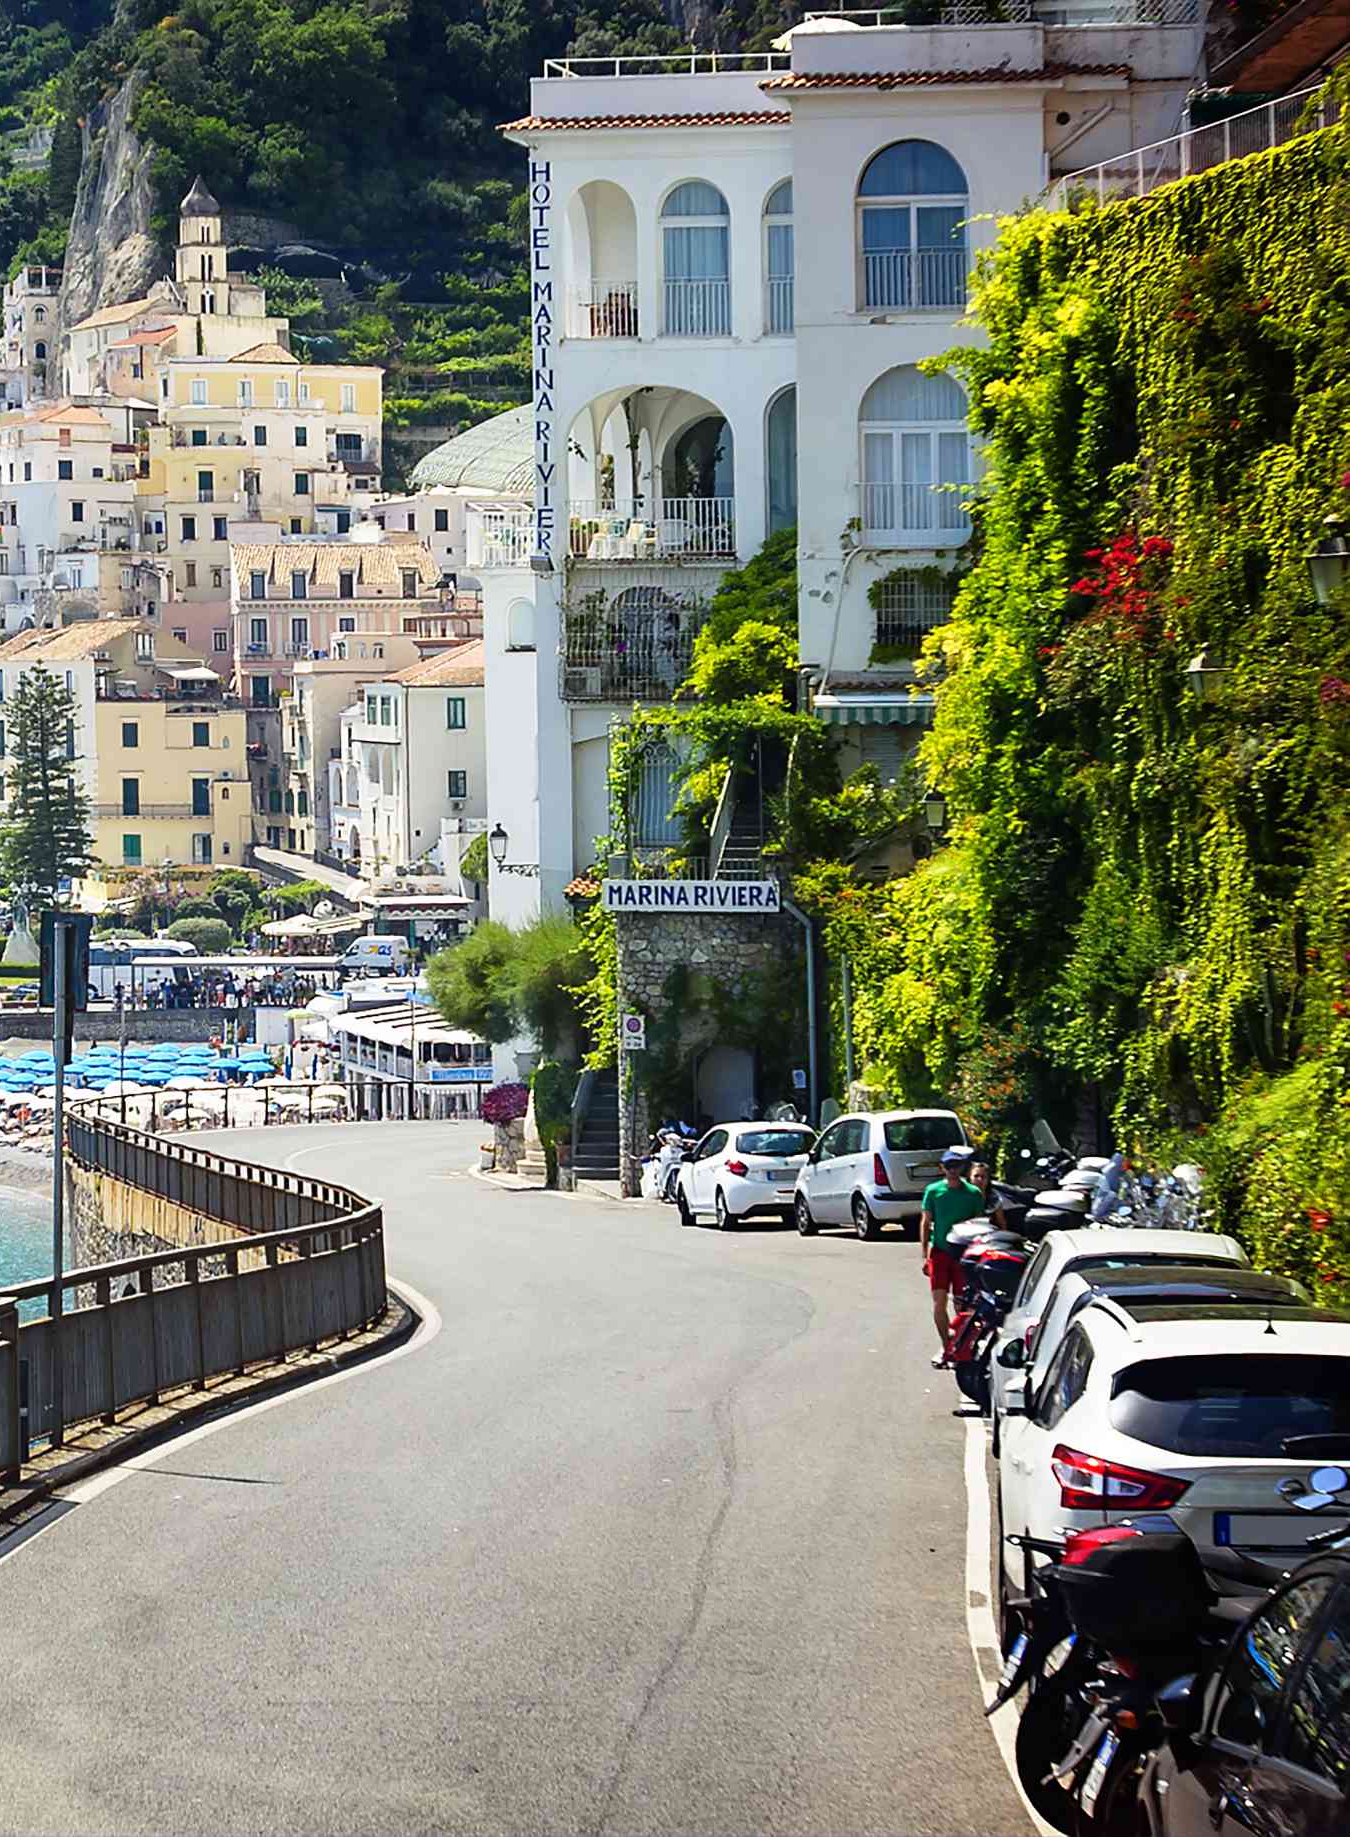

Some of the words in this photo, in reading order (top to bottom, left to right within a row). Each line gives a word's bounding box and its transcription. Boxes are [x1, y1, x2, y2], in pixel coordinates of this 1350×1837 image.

[532, 161, 550, 270] HOTEL
[534, 281, 554, 412] MARINA
[608, 885, 689, 906] MARINA
[694, 885, 778, 907] RIVIERA
